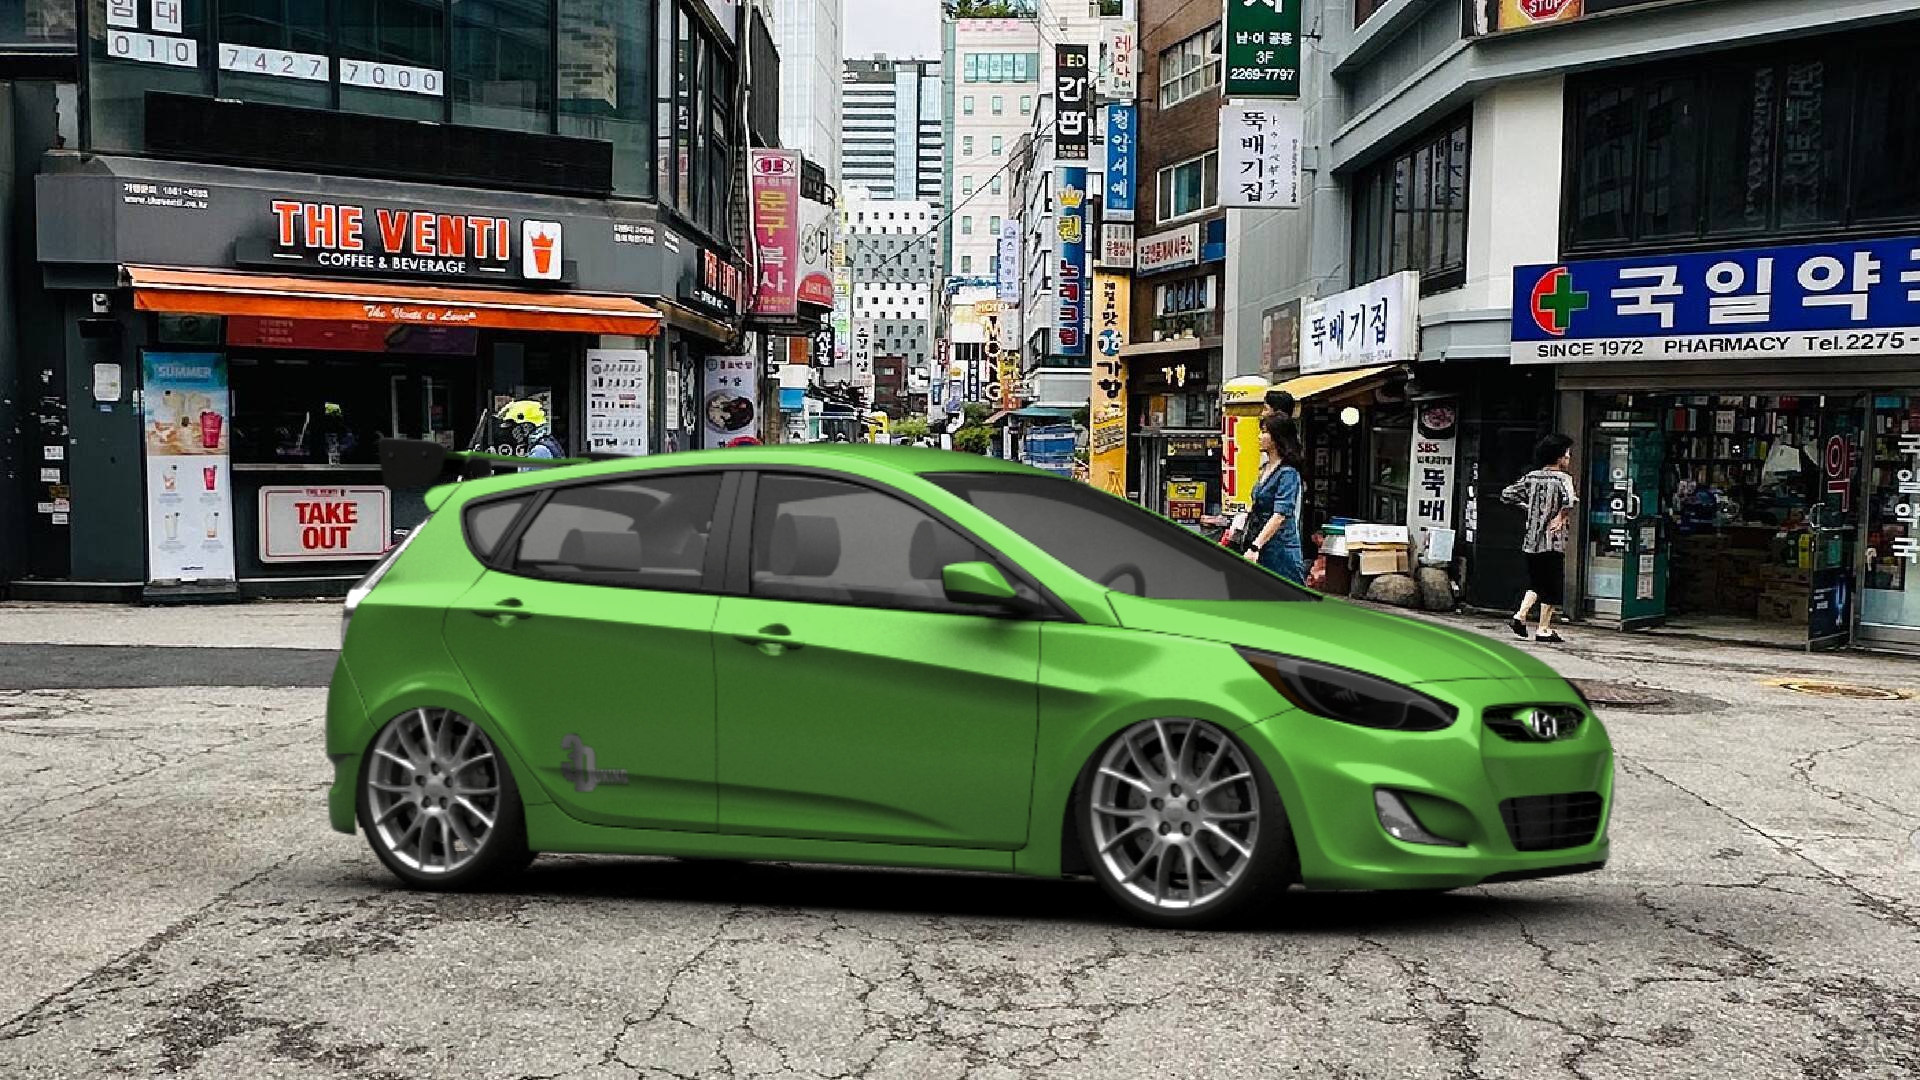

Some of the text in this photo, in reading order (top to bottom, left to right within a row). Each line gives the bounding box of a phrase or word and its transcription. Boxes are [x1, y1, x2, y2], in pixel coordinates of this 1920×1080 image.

[115, 35, 188, 62] 010
[1255, 51, 1275, 65] 3F
[227, 49, 437, 91] 7427 7000
[1059, 54, 1086, 67] LED
[1230, 69, 1295, 81] 2269-7797
[1241, 111, 1267, 202] 뚝배기집
[272, 200, 510, 261] THE VENTI
[318, 252, 466, 273] COFFEE & BEVERAGE
[1312, 297, 1388, 357] 뚝배기집
[1537, 343, 1594, 358] SINCE
[1599, 340, 1644, 355] 1972
[1664, 337, 1791, 354] PHARMACY
[1417, 442, 1440, 453] SBS
[295, 502, 358, 524] TAKE
[303, 526, 351, 549] OUT
